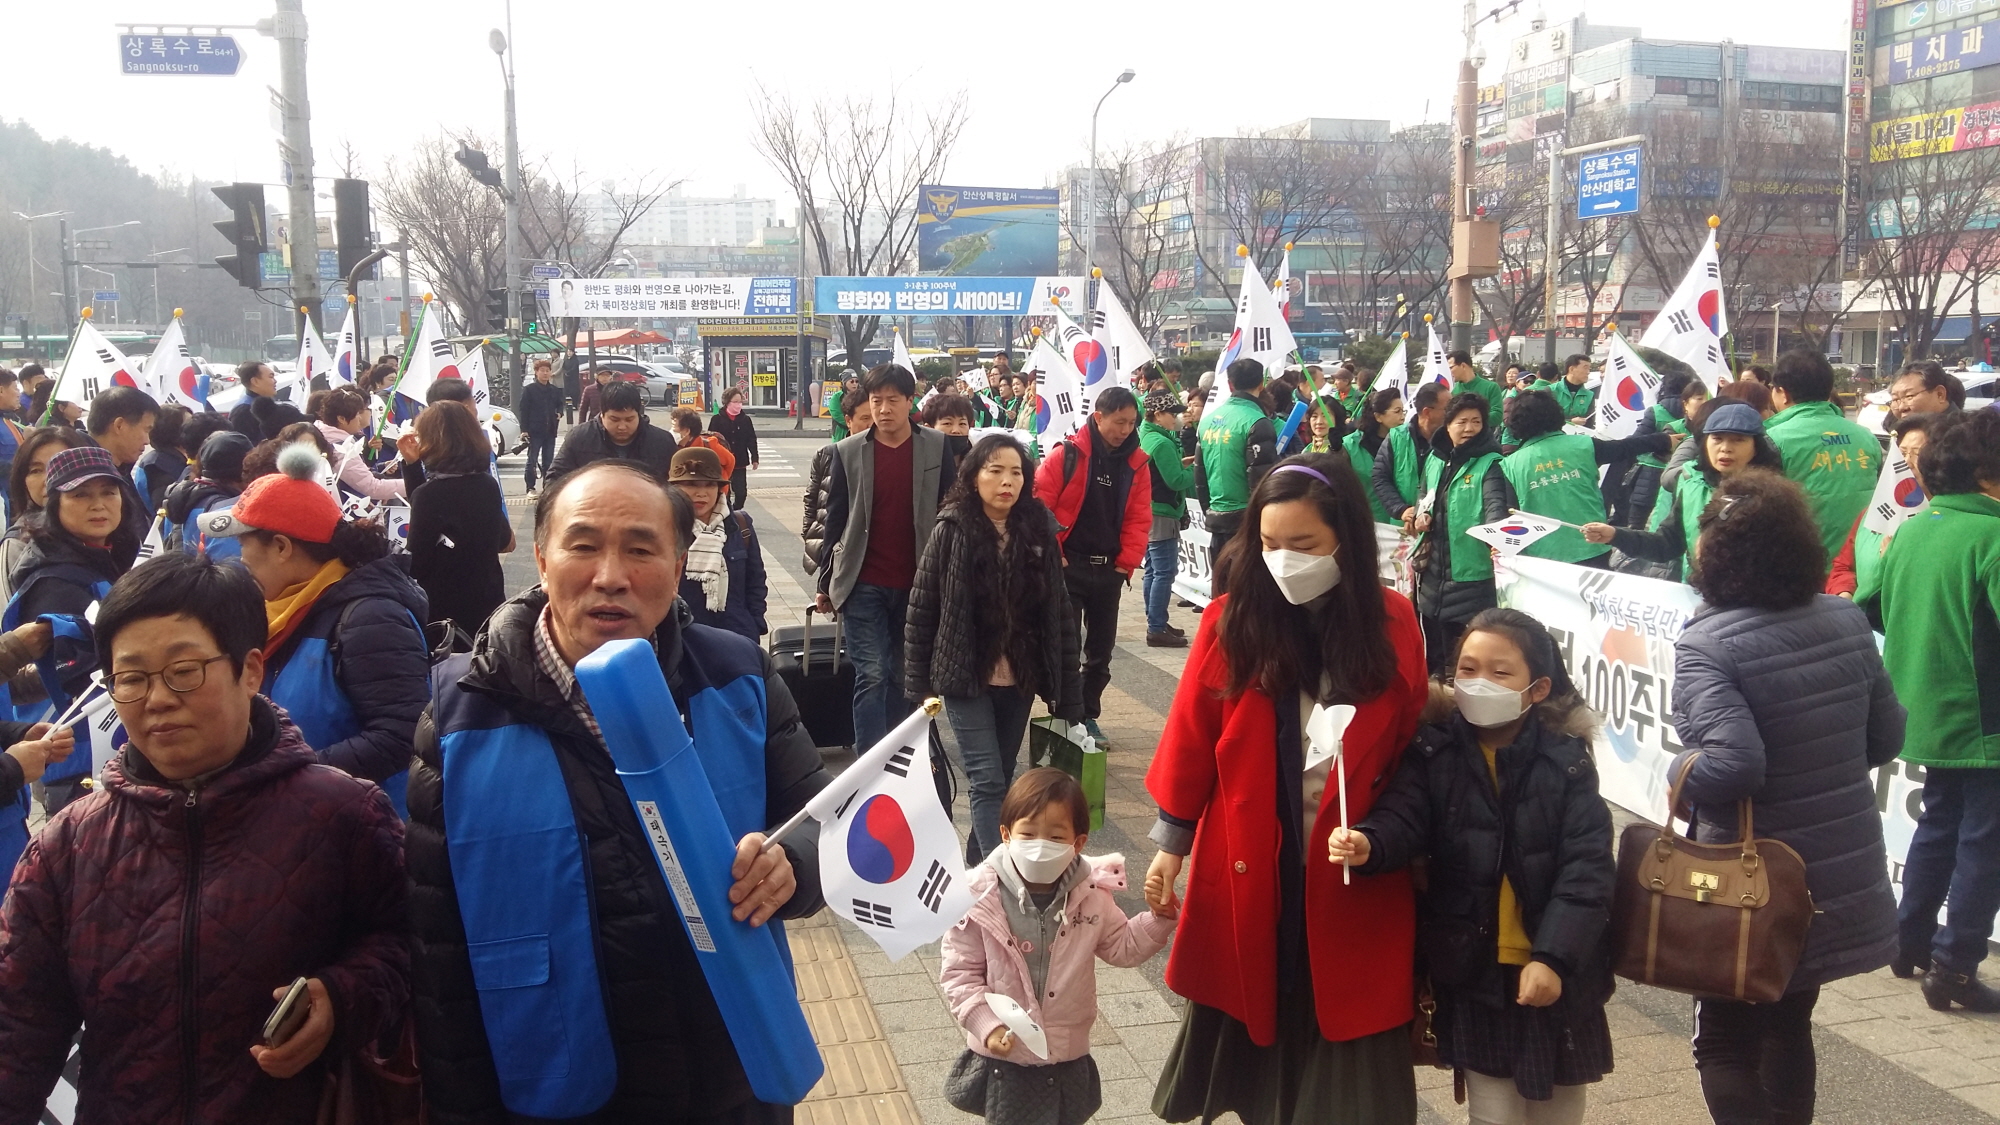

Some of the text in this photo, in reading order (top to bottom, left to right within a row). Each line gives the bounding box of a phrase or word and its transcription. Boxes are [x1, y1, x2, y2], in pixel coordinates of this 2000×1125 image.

[126, 38, 214, 57] 상록수로
[1852, 31, 1865, 78] 서울내과
[1894, 26, 1984, 68] 백치과
[127, 62, 199, 73] Sangnoksu-ro
[1906, 58, 1960, 80] T.408-2275
[1876, 115, 1957, 147] 서울내과
[1584, 152, 1637, 174] 상록수역
[1613, 169, 1630, 177] Station
[1581, 177, 1637, 198] 안산대학교
[963, 190, 1017, 202] 안산상록경찰서
[584, 283, 735, 296] 한반도 평화와 번영으로 나아가는길,
[930, 282, 957, 290] 100주년
[584, 299, 741, 311] 2차 북미정상회담 개최를 환영합니다!
[754, 294, 790, 307] 전해철
[837, 291, 1023, 311] 평화와 번영의 새100년!
[528, 322, 536, 334] 2
[754, 375, 775, 384] 가방수선
[1820, 434, 1852, 447] SMU
[1811, 448, 1870, 472] 새마을
[1529, 468, 1581, 490] 교통봉사대
